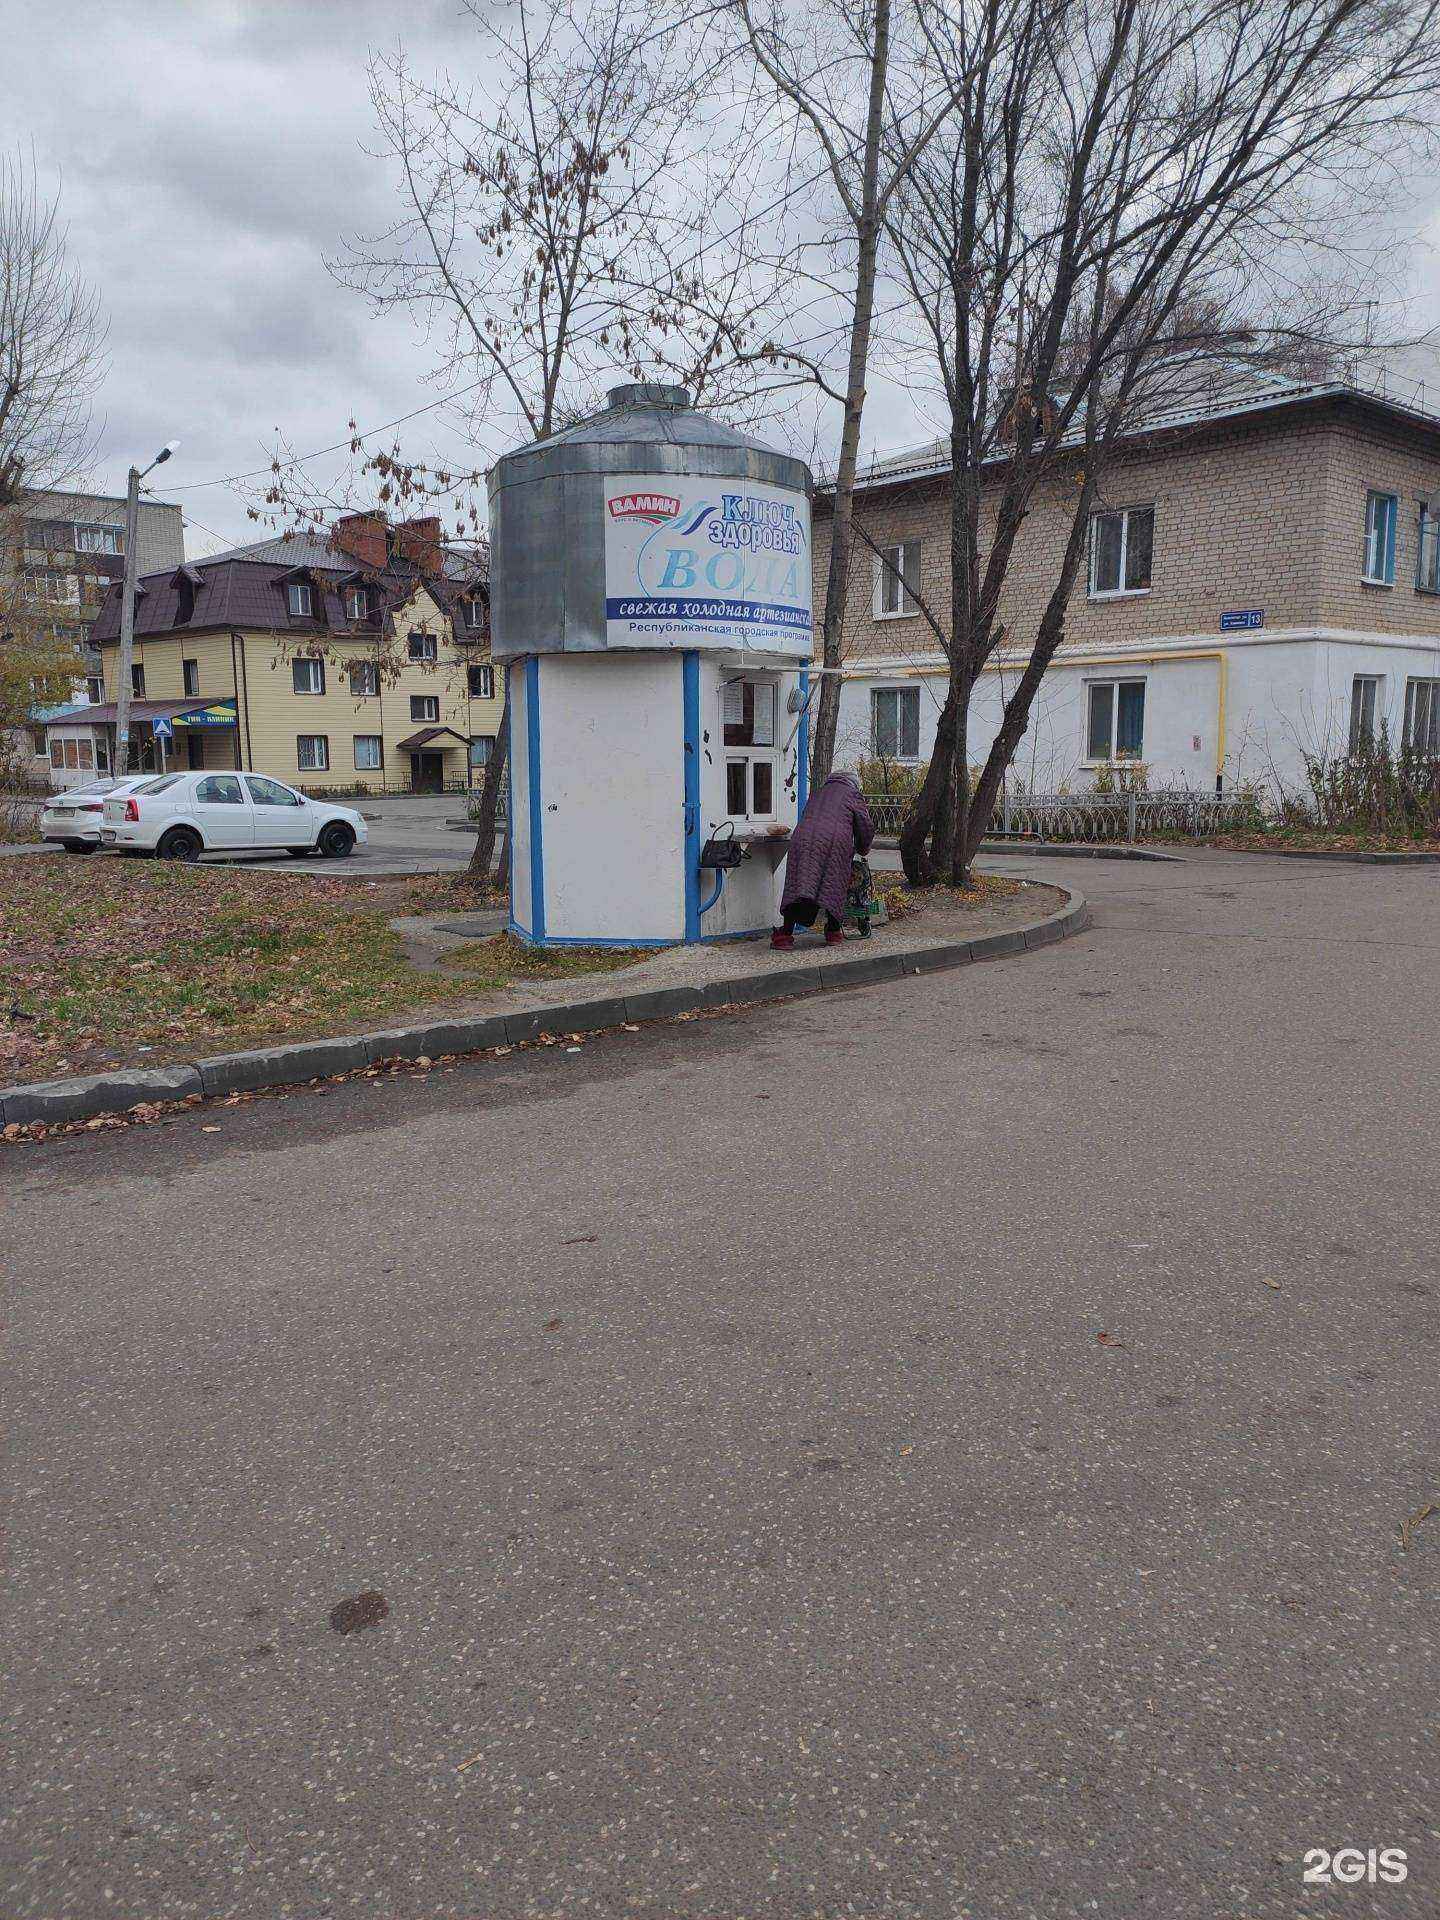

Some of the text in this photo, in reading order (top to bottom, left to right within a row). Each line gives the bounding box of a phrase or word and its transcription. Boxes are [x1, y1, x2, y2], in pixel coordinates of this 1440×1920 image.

[611, 496, 677, 514] ВАМИН
[721, 494, 795, 531] КЛЮЧ
[619, 602, 678, 615] свежая
[681, 600, 750, 618] холодная
[1251, 614, 1261, 624] 13
[629, 622, 732, 634] Республиканская
[734, 626, 779, 637] городская
